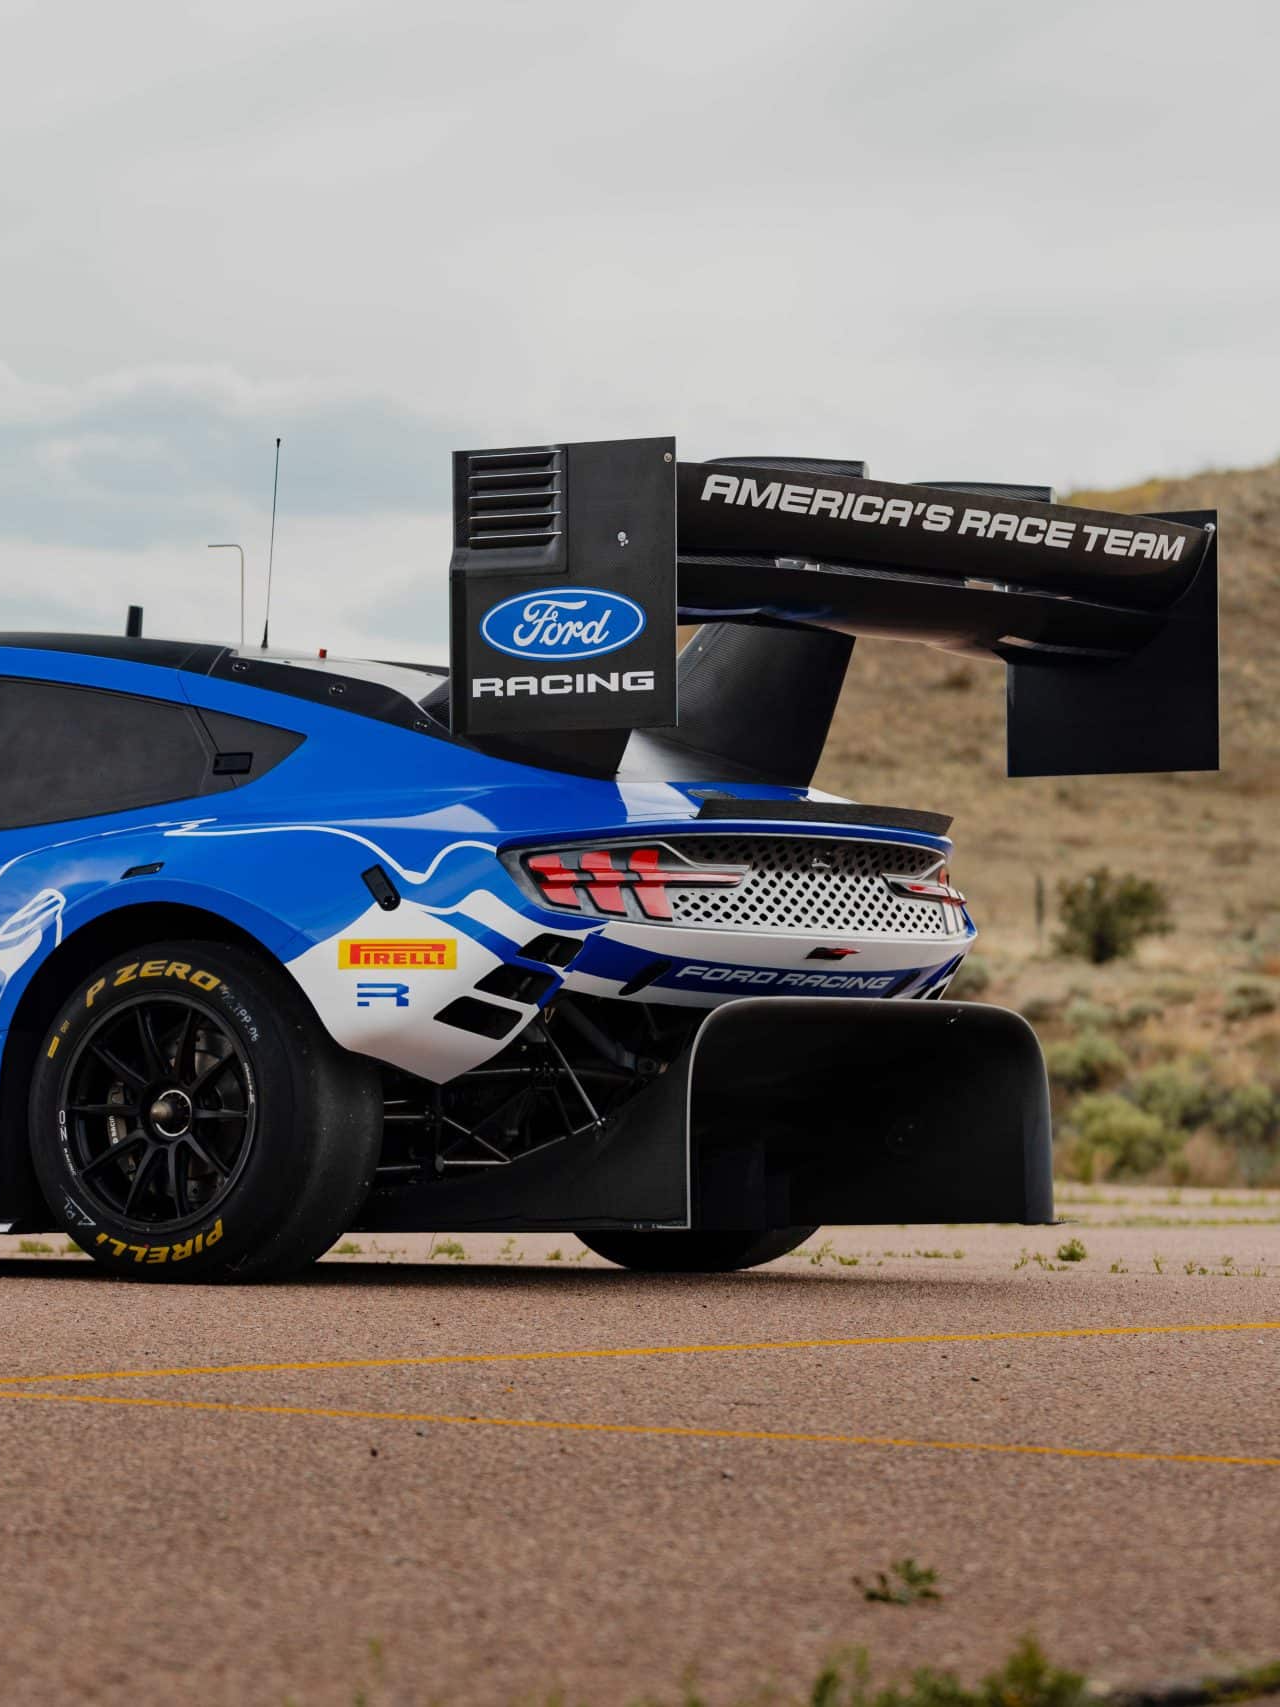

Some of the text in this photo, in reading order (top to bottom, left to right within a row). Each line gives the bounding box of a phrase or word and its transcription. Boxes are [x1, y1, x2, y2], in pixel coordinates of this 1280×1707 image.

[700, 474, 1187, 561] AMERICA'S RACE TEAM
[513, 600, 612, 647] Ford
[472, 671, 655, 698] RACING
[349, 943, 447, 965] PIRELLI
[85, 959, 223, 1008] P ZERO
[675, 965, 895, 990] FORD RACING
[96, 1219, 224, 1263] PIRELLI
